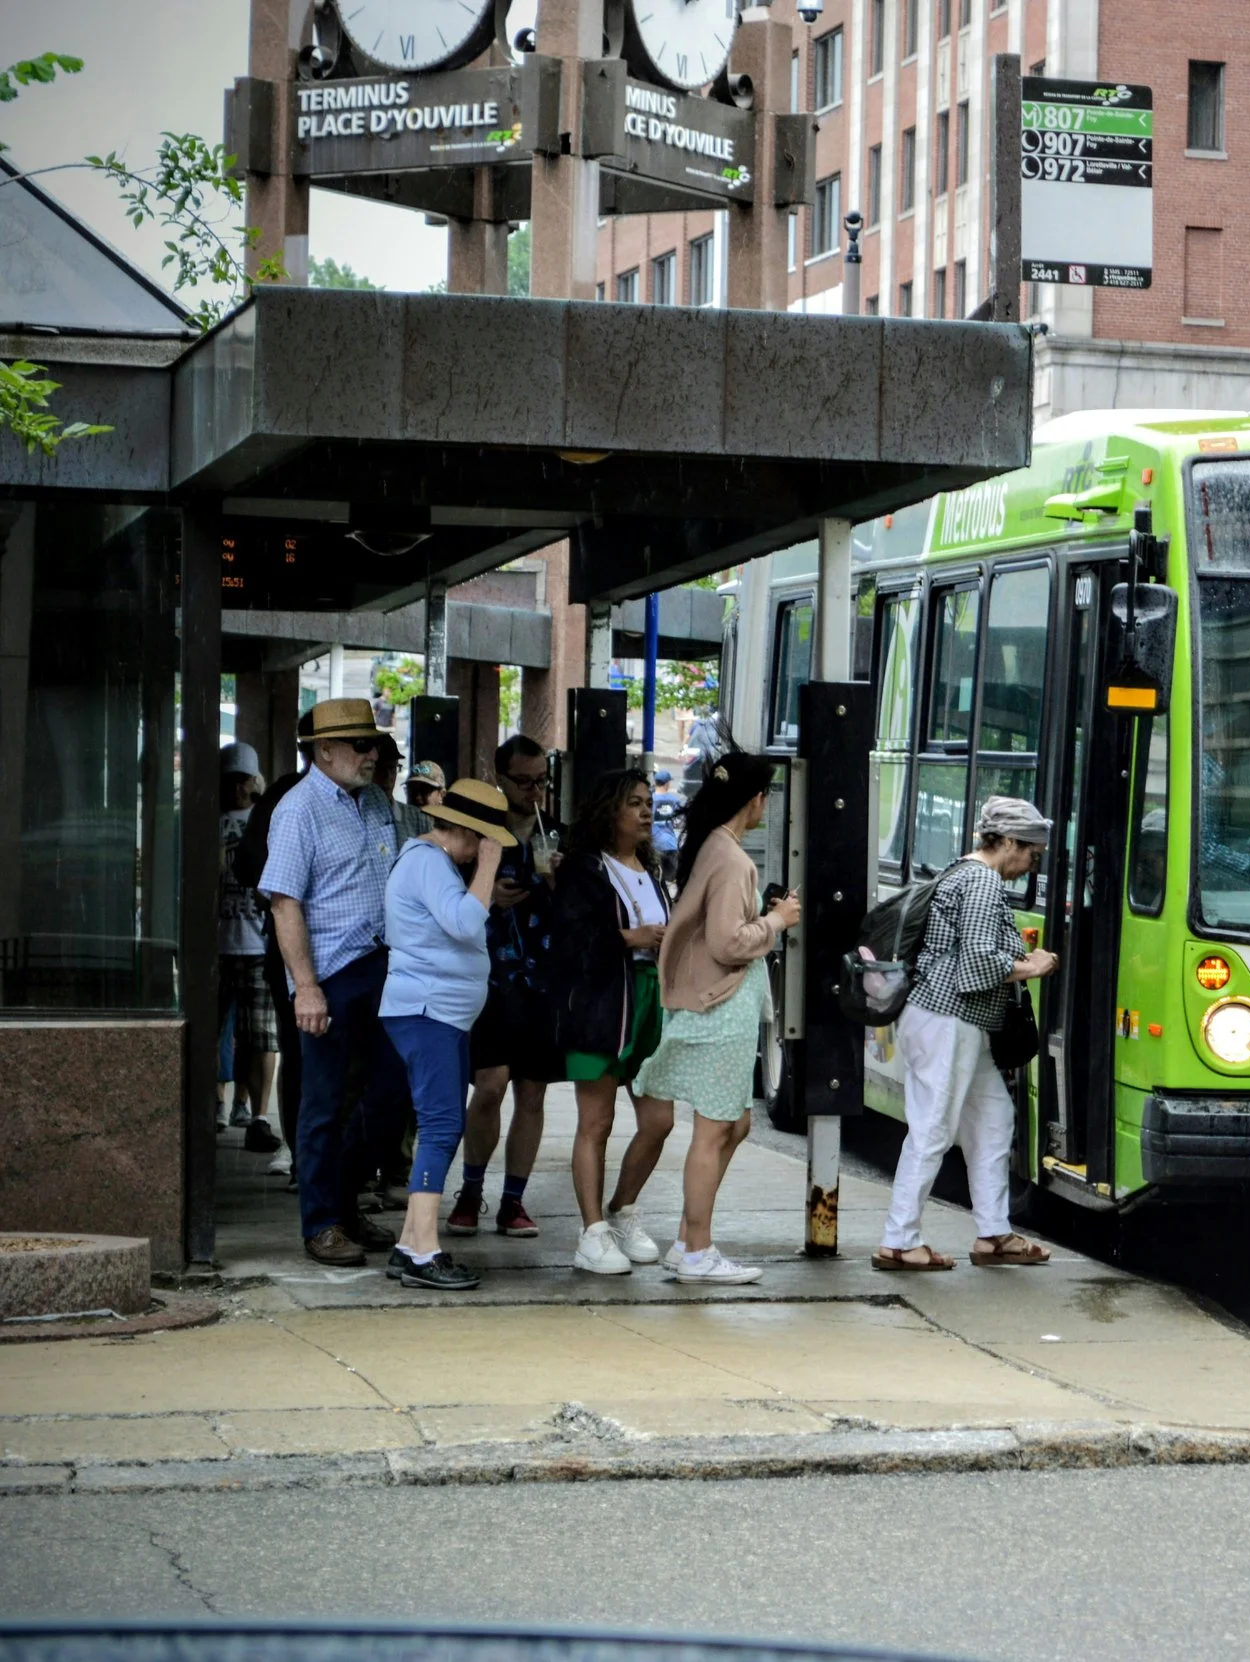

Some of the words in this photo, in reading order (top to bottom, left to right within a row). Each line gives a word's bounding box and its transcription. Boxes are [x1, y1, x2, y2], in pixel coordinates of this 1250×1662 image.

[298, 82, 410, 112] TERMINUS
[626, 85, 677, 118] MINUS
[298, 110, 366, 138] PLACE
[370, 102, 498, 133] D'YOUVILLE
[1044, 106, 1085, 130] 807
[649, 118, 734, 161] D'YOUVILLE
[1044, 132, 1085, 156] 907
[1086, 141, 1098, 150] Foy
[1044, 158, 1086, 183] 972
[1031, 268, 1060, 281] 2441
[1075, 577, 1091, 605] 0970
